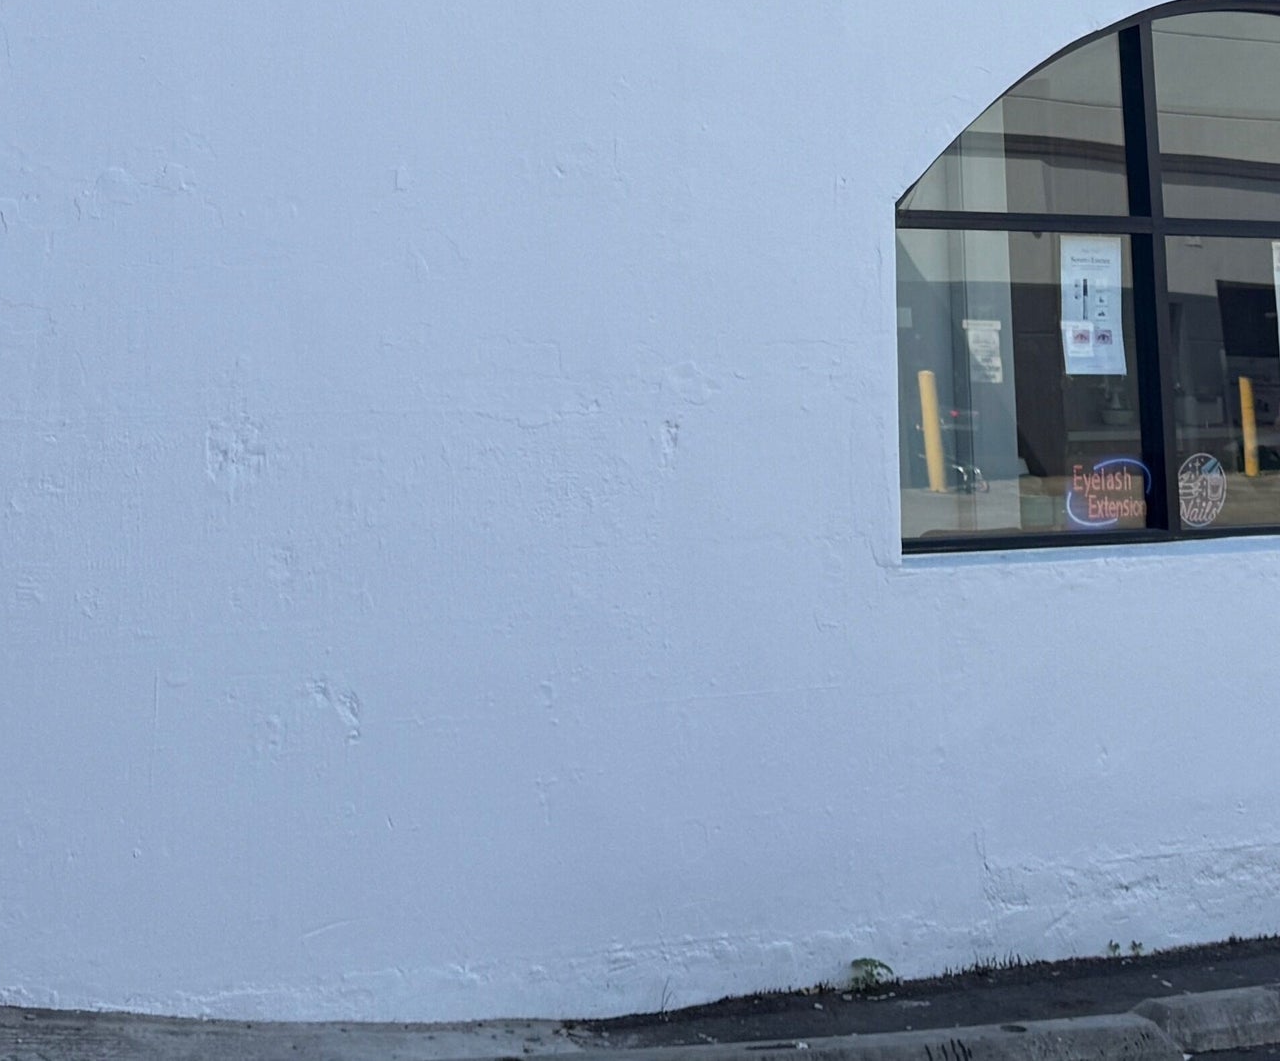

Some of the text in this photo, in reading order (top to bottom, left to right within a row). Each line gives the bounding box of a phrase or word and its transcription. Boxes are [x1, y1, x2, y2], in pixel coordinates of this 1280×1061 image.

[1072, 464, 1132, 498] Eyelash
[1088, 494, 1147, 519] Extension
[1180, 500, 1217, 522] Nails
